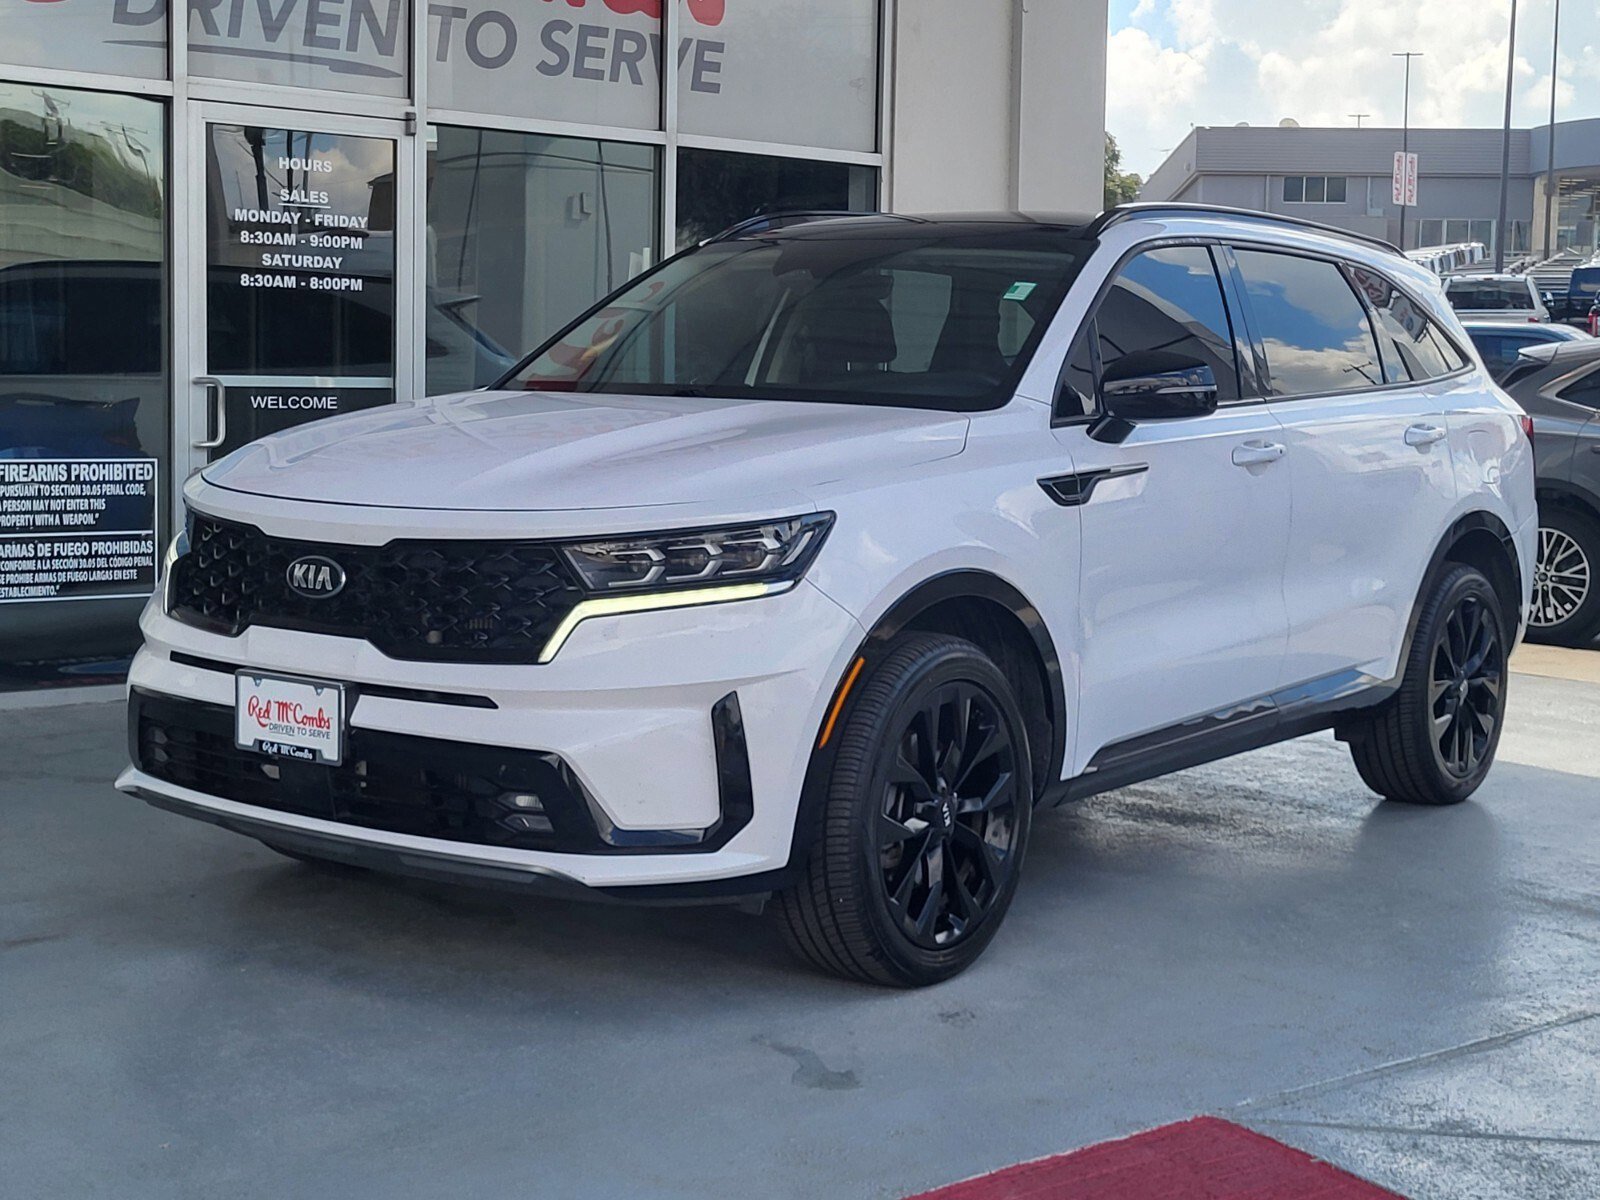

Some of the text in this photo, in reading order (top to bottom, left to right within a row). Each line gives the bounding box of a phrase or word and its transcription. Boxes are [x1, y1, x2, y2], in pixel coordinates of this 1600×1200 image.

[427, 3, 518, 69] TO
[278, 157, 333, 173] HOURS
[279, 189, 329, 204] SALES
[234, 209, 301, 225] MONDAY
[314, 214, 368, 229] FRIDAY
[240, 231, 296, 246] 8:30AM
[309, 235, 363, 249] 9:00PM
[262, 253, 343, 269] SATURDAY
[240, 274, 296, 288] 8:30AM
[310, 277, 363, 291] 8:00PM
[250, 395, 338, 409] WELCOME
[71, 463, 153, 481] PROHIBITED
[40, 484, 50, 497] TO
[51, 484, 81, 496] SECTION
[82, 484, 101, 496] 30.05
[102, 483, 124, 495] PENAL
[3, 499, 31, 511] PERSON
[33, 499, 49, 511] MAY
[50, 499, 65, 511] NOT
[66, 498, 89, 510] ENTER
[90, 498, 106, 510] THIS
[35, 513, 54, 526] WITH
[55, 513, 60, 525] A
[0, 540, 153, 558] ARMAS DE FUEGO PROHIBIDAS
[1, 559, 36, 571] CONFORME
[37, 559, 41, 570] A
[42, 559, 51, 570] LA
[79, 558, 96, 569] 30.05
[96, 557, 108, 568] DEL
[133, 556, 153, 566] PENAL
[6, 573, 34, 584] PROHIBE
[34, 572, 57, 583] ARMAS
[57, 571, 66, 582] DE
[67, 571, 88, 582] FUEGO
[89, 570, 113, 581] LARGAS
[113, 569, 122, 580] EN
[122, 569, 138, 580] ESTE
[293, 563, 333, 591] KIA
[248, 695, 331, 730] Red McCombs
[268, 722, 331, 739] DRIVEN TO SERVE
